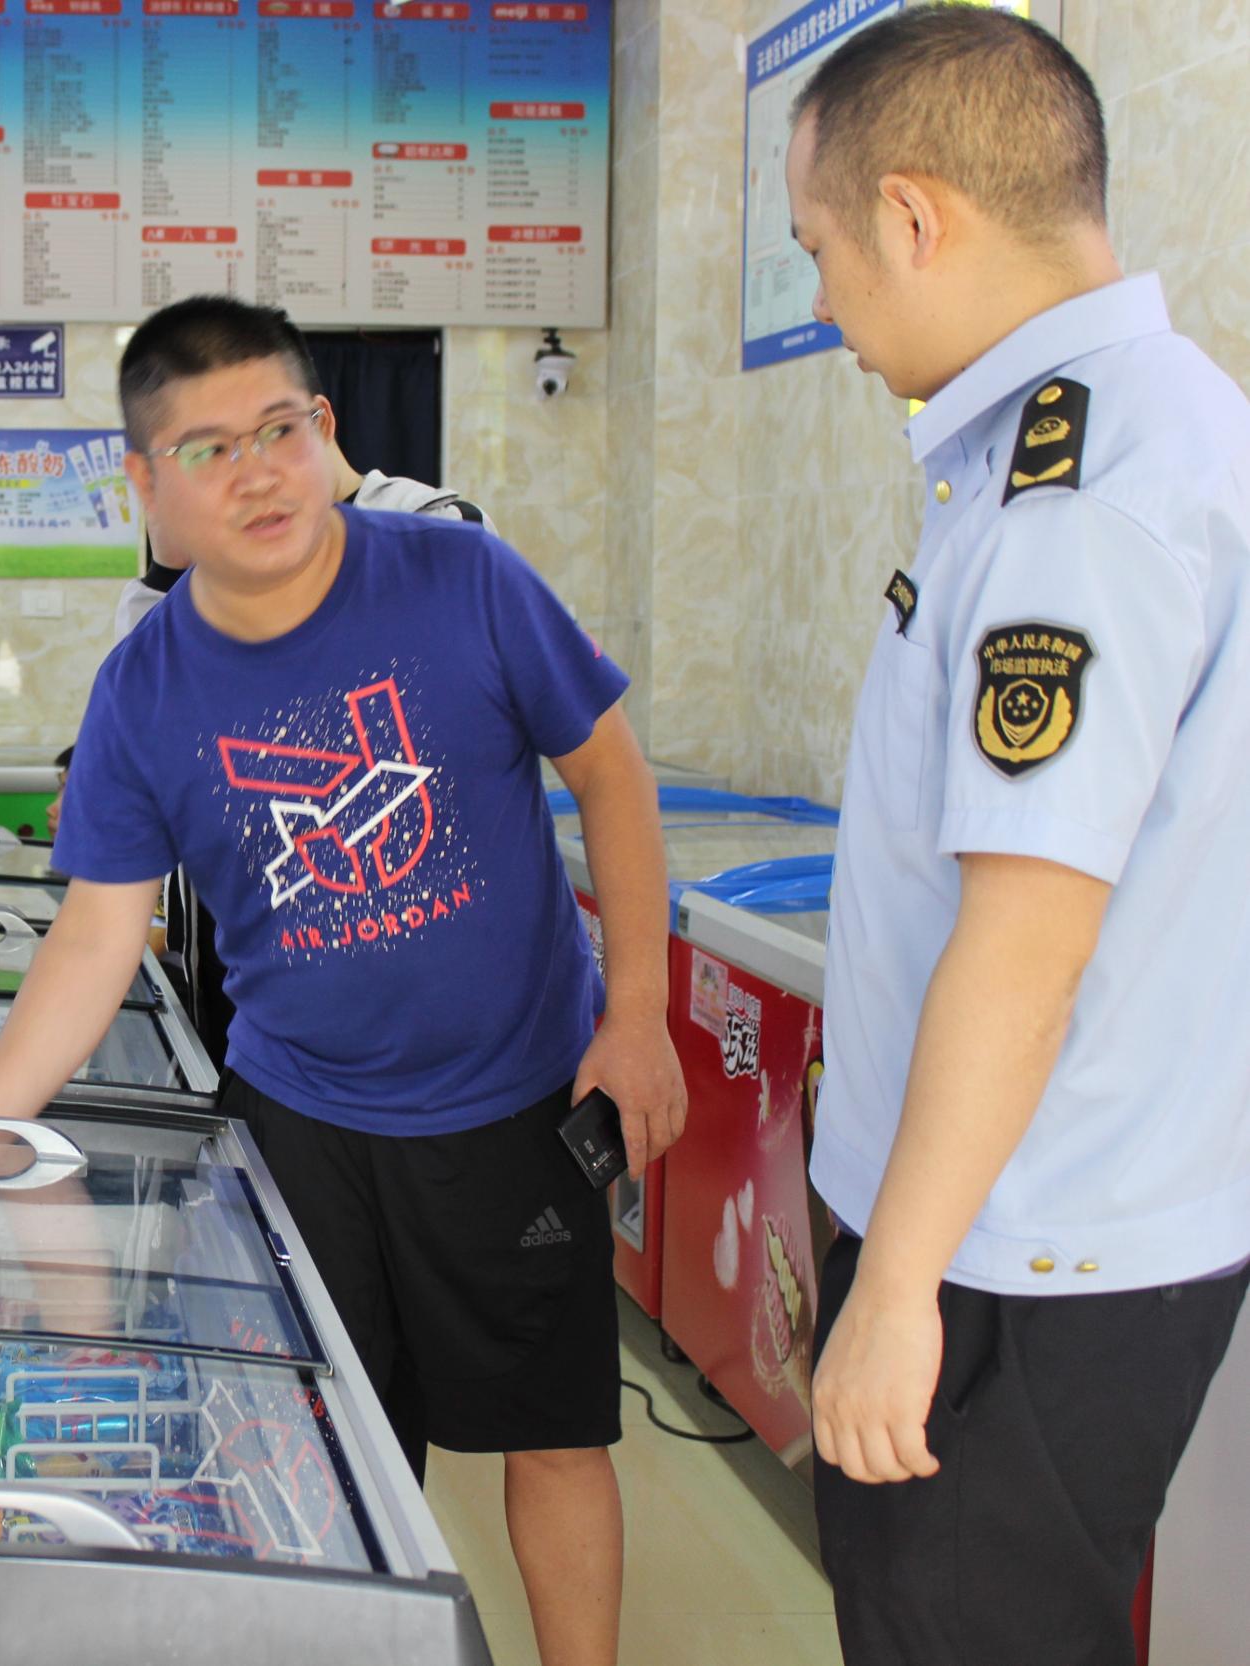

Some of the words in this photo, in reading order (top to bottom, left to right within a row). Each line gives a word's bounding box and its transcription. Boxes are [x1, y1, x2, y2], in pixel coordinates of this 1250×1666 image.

[984, 633, 1082, 662] 中华人民共和国
[990, 656, 1070, 677] 市场监管执法
[281, 929, 325, 950] AIR
[339, 883, 472, 947] JORDAN
[520, 1230, 572, 1248] adidas
